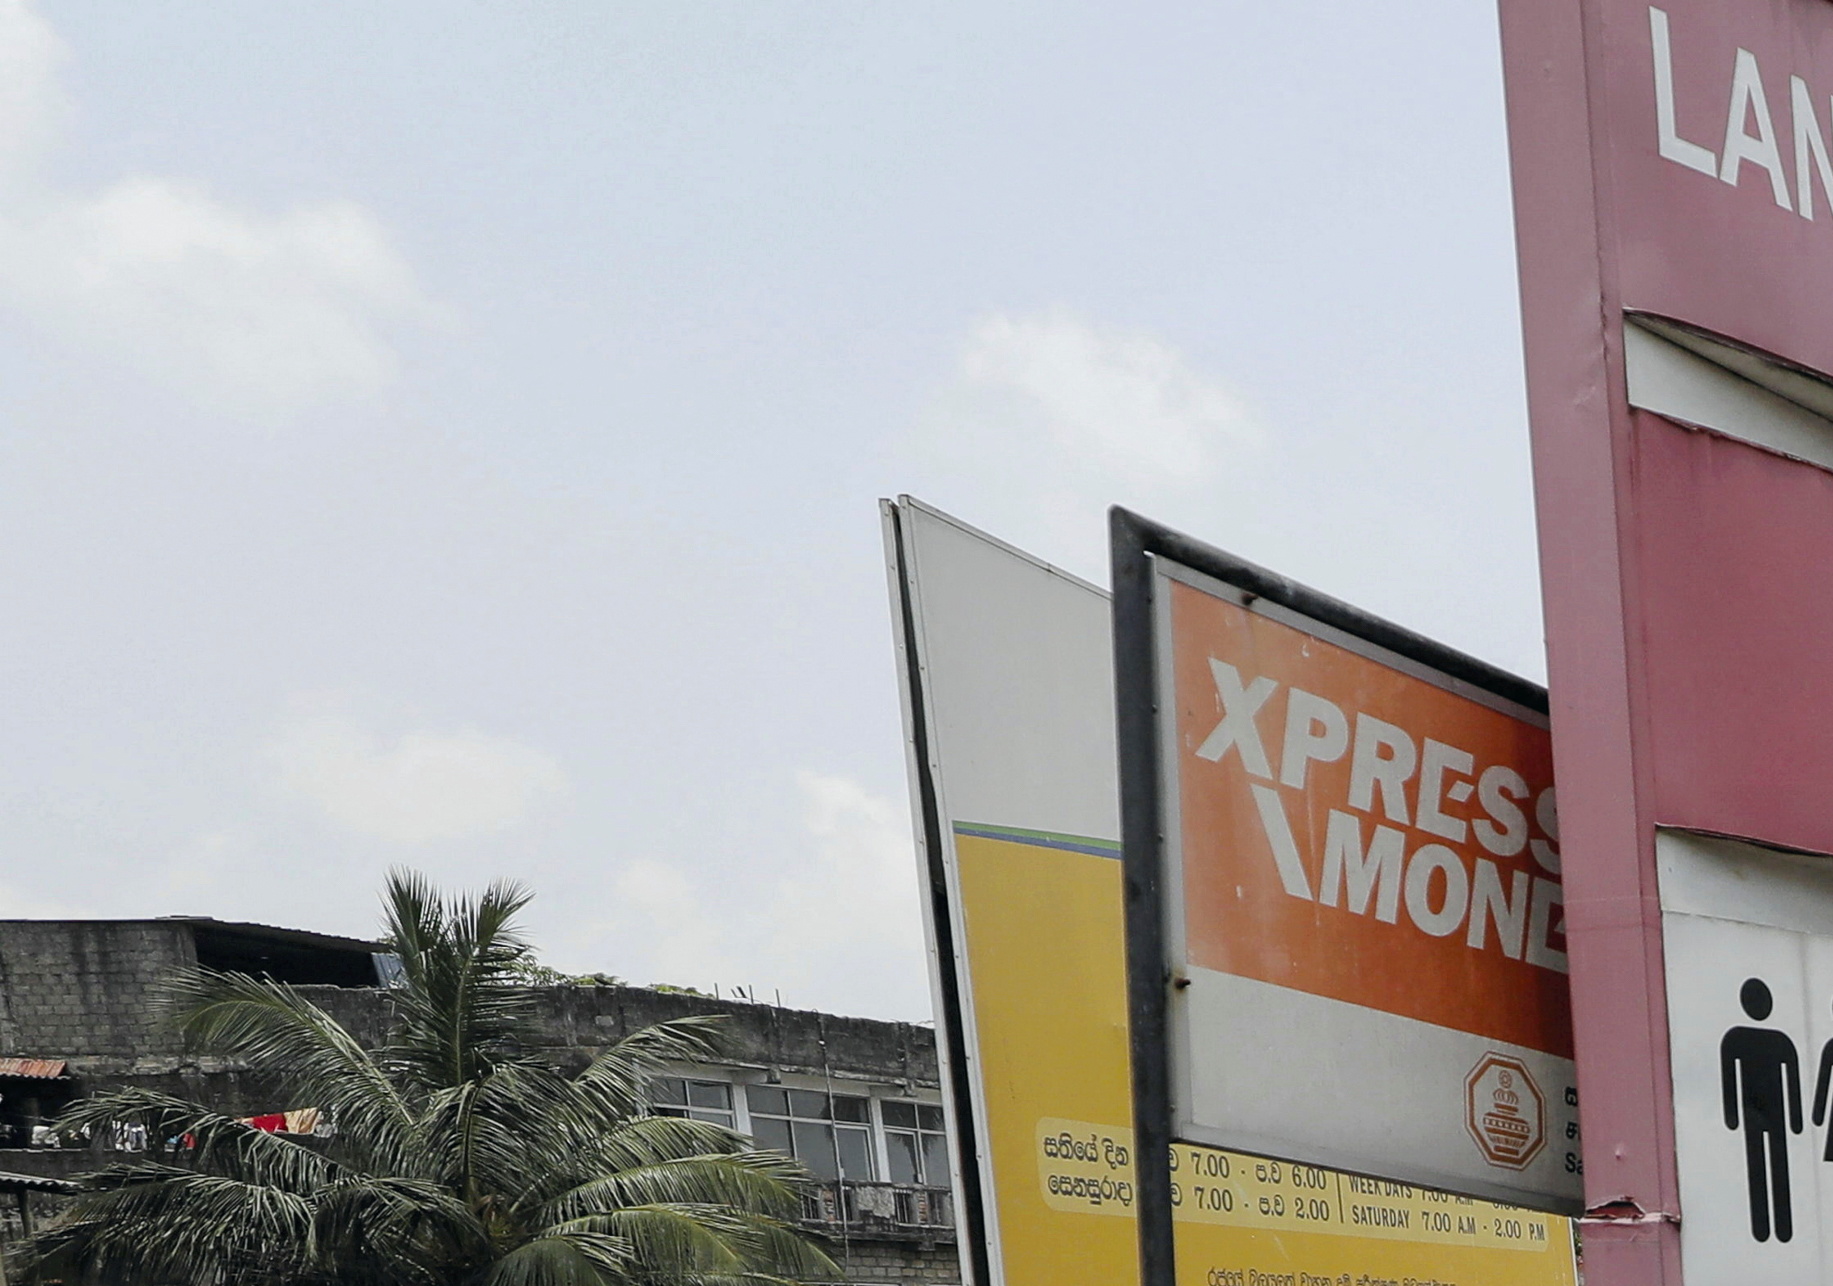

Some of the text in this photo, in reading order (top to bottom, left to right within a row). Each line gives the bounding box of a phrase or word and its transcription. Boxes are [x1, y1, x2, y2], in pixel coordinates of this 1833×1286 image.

[1319, 808, 1571, 975] MONE
[1100, 1137, 1130, 1170] දින
[1190, 1152, 1230, 1178] 7.00
[1292, 1164, 1327, 1190] 6.00
[1194, 1186, 1233, 1212] 7.00
[1294, 1199, 1330, 1221] 2.00
[1351, 1205, 1410, 1229] SATURDAY
[1421, 1212, 1451, 1233] 7.00
[1457, 1215, 1477, 1235] A.M
[1494, 1218, 1522, 1240] 2.00
[1528, 1222, 1546, 1242] P.M
